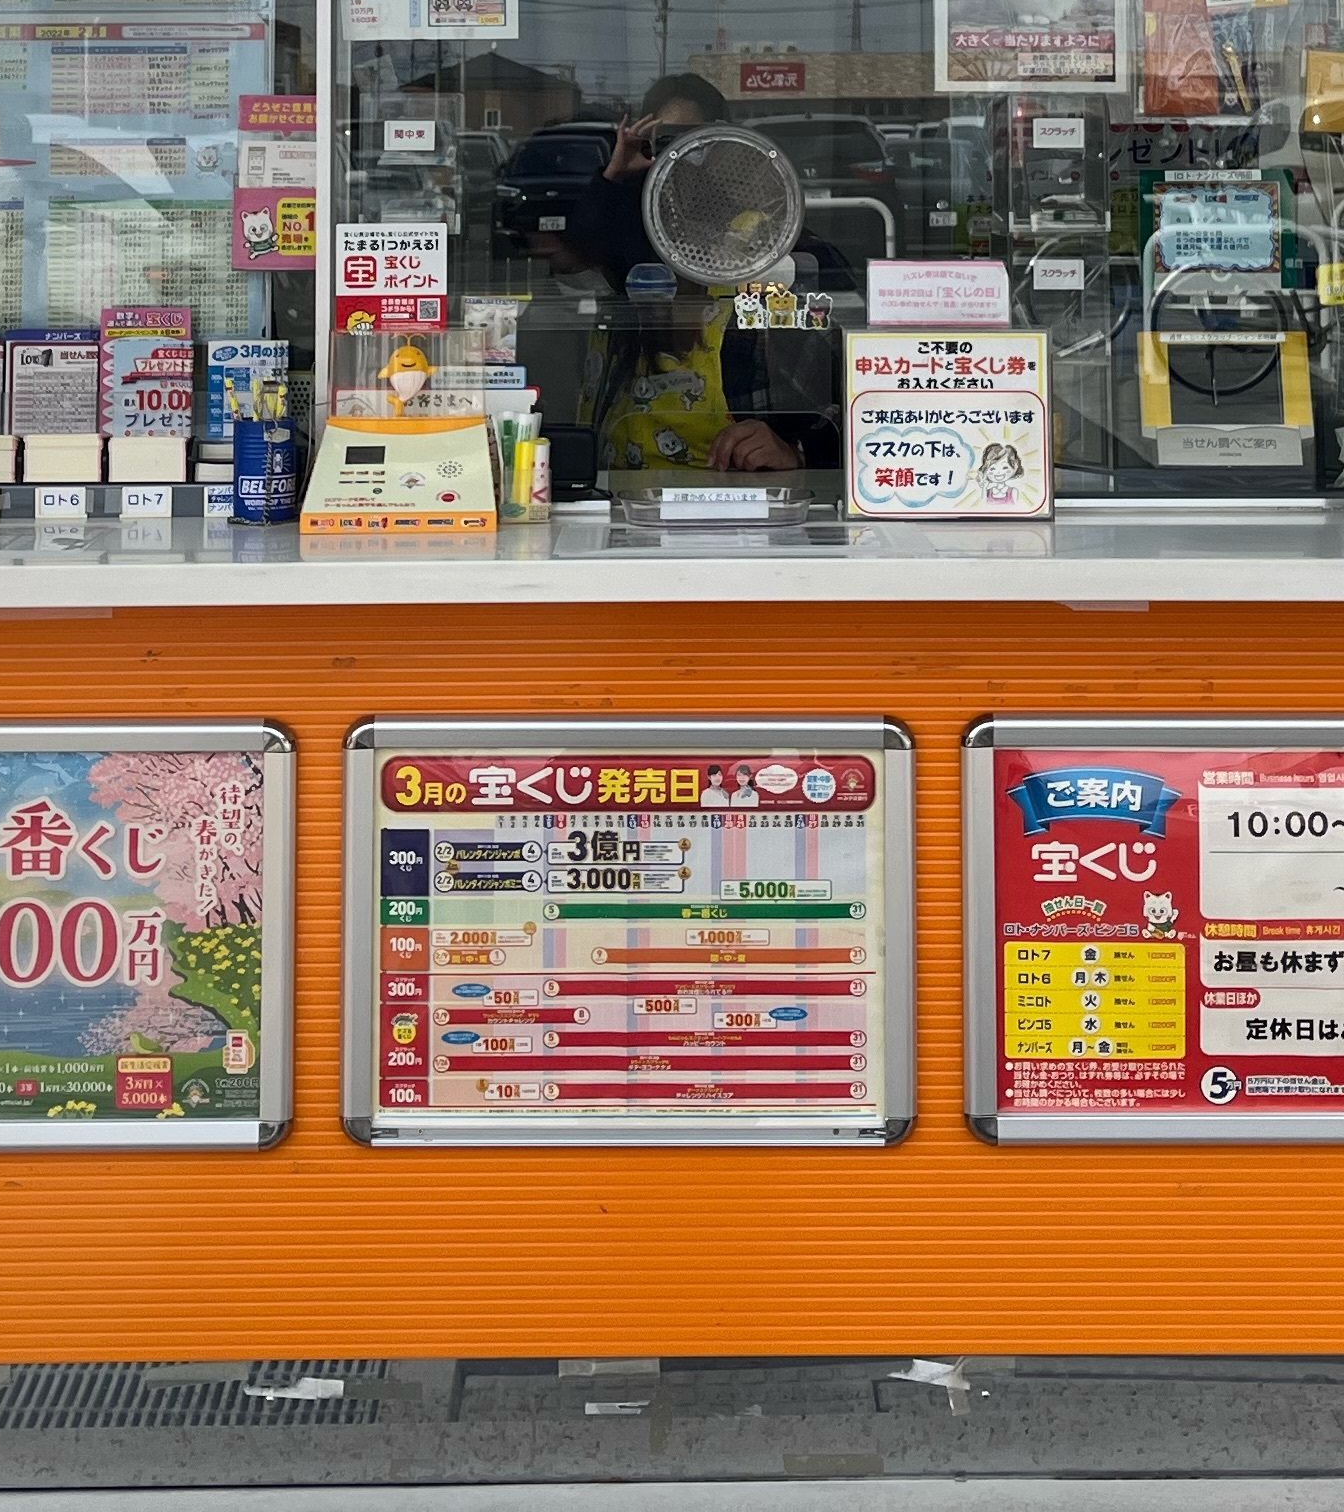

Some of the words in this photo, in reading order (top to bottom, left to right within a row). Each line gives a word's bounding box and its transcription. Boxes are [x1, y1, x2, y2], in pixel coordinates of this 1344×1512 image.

[956, 34, 990, 47] 大きく
[1005, 34, 1099, 47] 当たりますように
[1040, 127, 1077, 135] スクラッチ
[344, 240, 439, 251] たまる!つかえる!
[384, 256, 420, 269] 宝くじ
[1040, 268, 1077, 278] スクラッチ
[384, 274, 438, 288] ポイント
[147, 313, 183, 326] 宝くじ
[918, 341, 972, 355] ご不要の
[856, 356, 1036, 375] 申込カードと宝くじ券を
[897, 378, 993, 389] お入れください
[861, 410, 1035, 424] ご来店ありがとうございます
[866, 441, 961, 458] マスクの下は、
[1182, 438, 1277, 449] 当せん調べご案内
[875, 468, 953, 487] 笑顔です!
[43, 494, 79, 506] ロト6
[128, 494, 163, 506] ロト7
[1203, 771, 1253, 784] 営業時間
[1260, 774, 1292, 782] Business
[1294, 774, 1314, 782] hours
[395, 765, 699, 806] 3月の宝くじ発売日
[1047, 778, 1142, 811] ご案内
[220, 785, 240, 851] 待望の、
[438, 847, 451, 855] 2/2
[457, 850, 520, 859] バレンタインジャンボ
[528, 846, 535, 855] 4
[567, 830, 641, 862] 3億円
[389, 851, 423, 865] 300円
[1032, 841, 1157, 882] 宝くじ
[195, 820, 216, 912] 春がきた!
[438, 876, 451, 884] 2/2
[455, 879, 522, 889] バレンタインジャンボミニ
[528, 874, 535, 883] 4
[567, 868, 641, 890] 3,000万円
[739, 882, 796, 898] 5,000万円
[389, 902, 422, 914] 200円
[549, 906, 554, 914] 5
[1043, 897, 1104, 913] 抽せん日一覧
[1005, 924, 1139, 935] ロト・ナンバーズ・ビンゴ5
[1205, 923, 1256, 937] 休憩時間
[1263, 926, 1282, 935] Break
[1285, 926, 1300, 935] time
[390, 938, 422, 951] 100円
[853, 950, 862, 958] 31
[1018, 950, 1051, 961] ロト7
[1084, 948, 1097, 960] 金
[1018, 973, 1051, 984] ロト6
[1075, 972, 1085, 983] 月
[1095, 972, 1106, 983] 木
[388, 983, 422, 996] 300円
[1018, 996, 1051, 1007] ミニロト
[1085, 995, 1097, 1007] 火
[1205, 992, 1257, 1005] 休業日ほか
[645, 999, 679, 1012] 500万円
[725, 1013, 760, 1026] 300万円
[1018, 1019, 1051, 1029] ビンゴ5
[1085, 1018, 1097, 1030] 水
[853, 1034, 862, 1042] 31
[483, 1039, 514, 1051] 100万円
[1018, 1042, 1052, 1053] ナンバーズ
[388, 1052, 422, 1066] 200円
[389, 1089, 421, 1102] 100円
